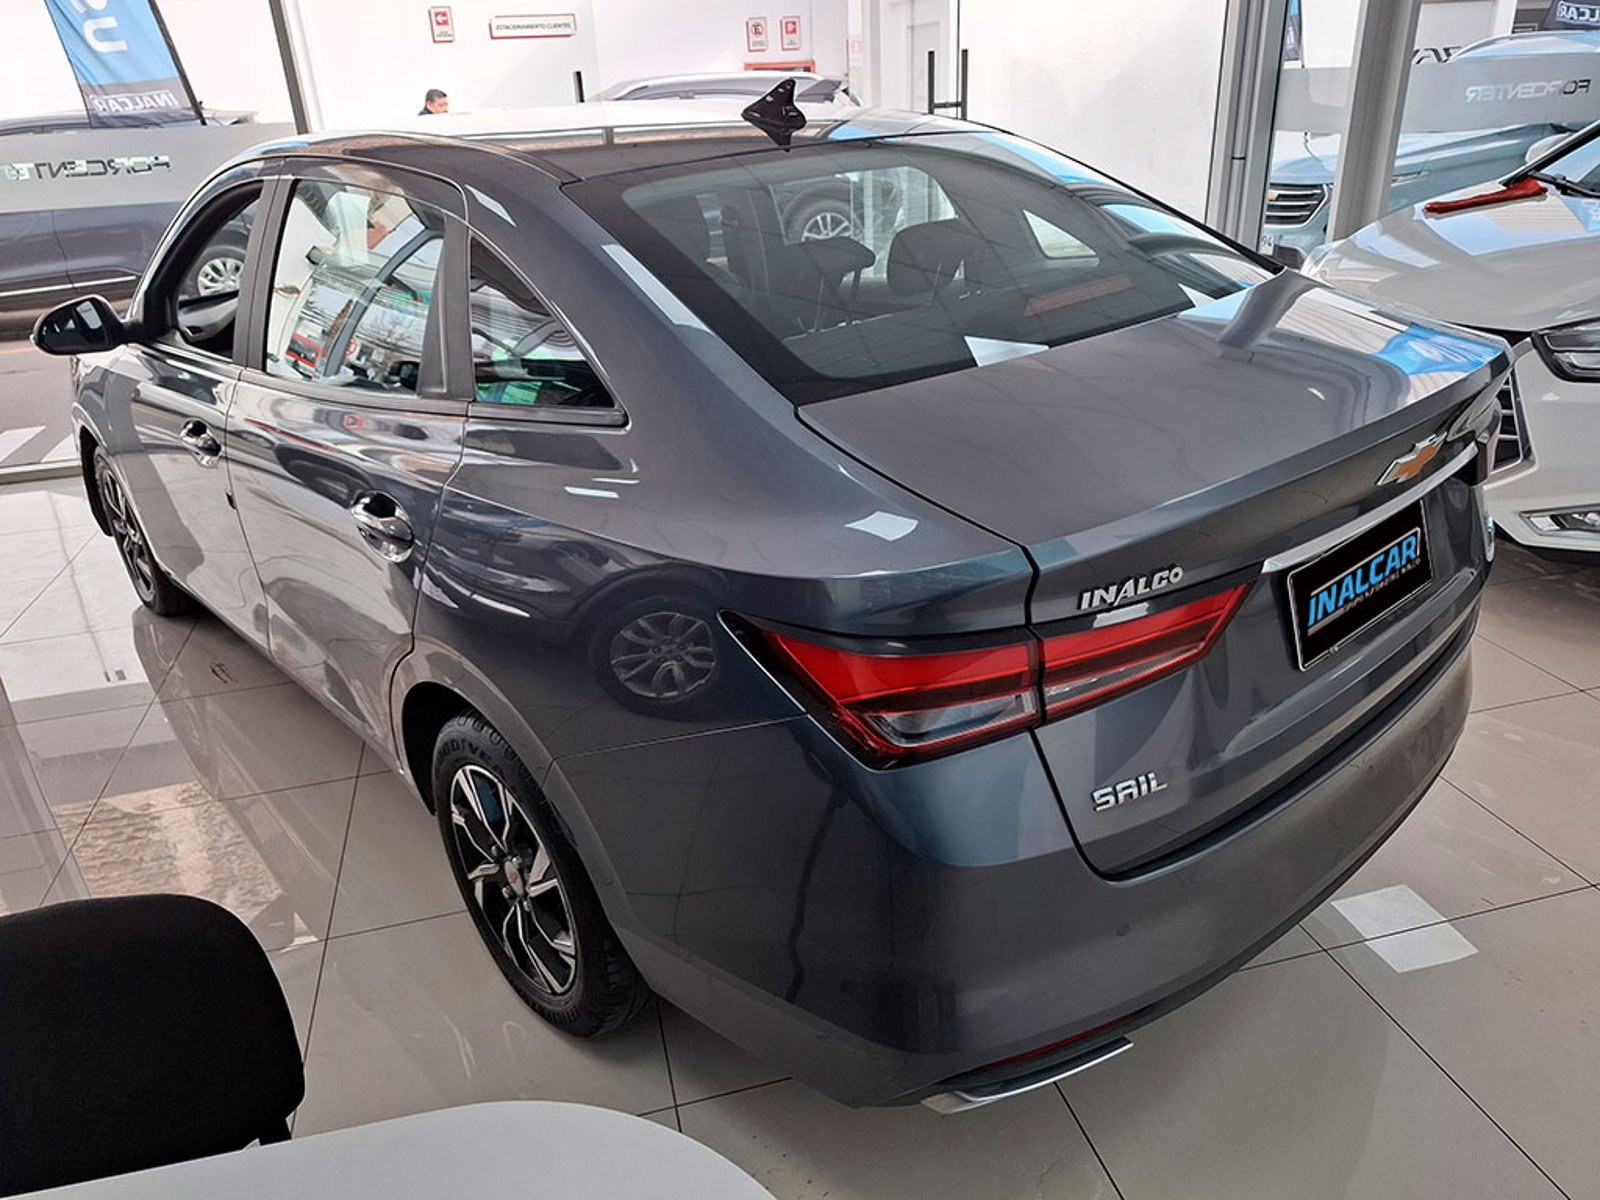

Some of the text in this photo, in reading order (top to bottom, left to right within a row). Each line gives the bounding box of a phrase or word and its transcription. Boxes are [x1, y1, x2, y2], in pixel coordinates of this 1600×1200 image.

[1080, 566, 1184, 610] INALCO
[1307, 534, 1417, 628] INALCAR
[1092, 771, 1168, 812] SAIL
